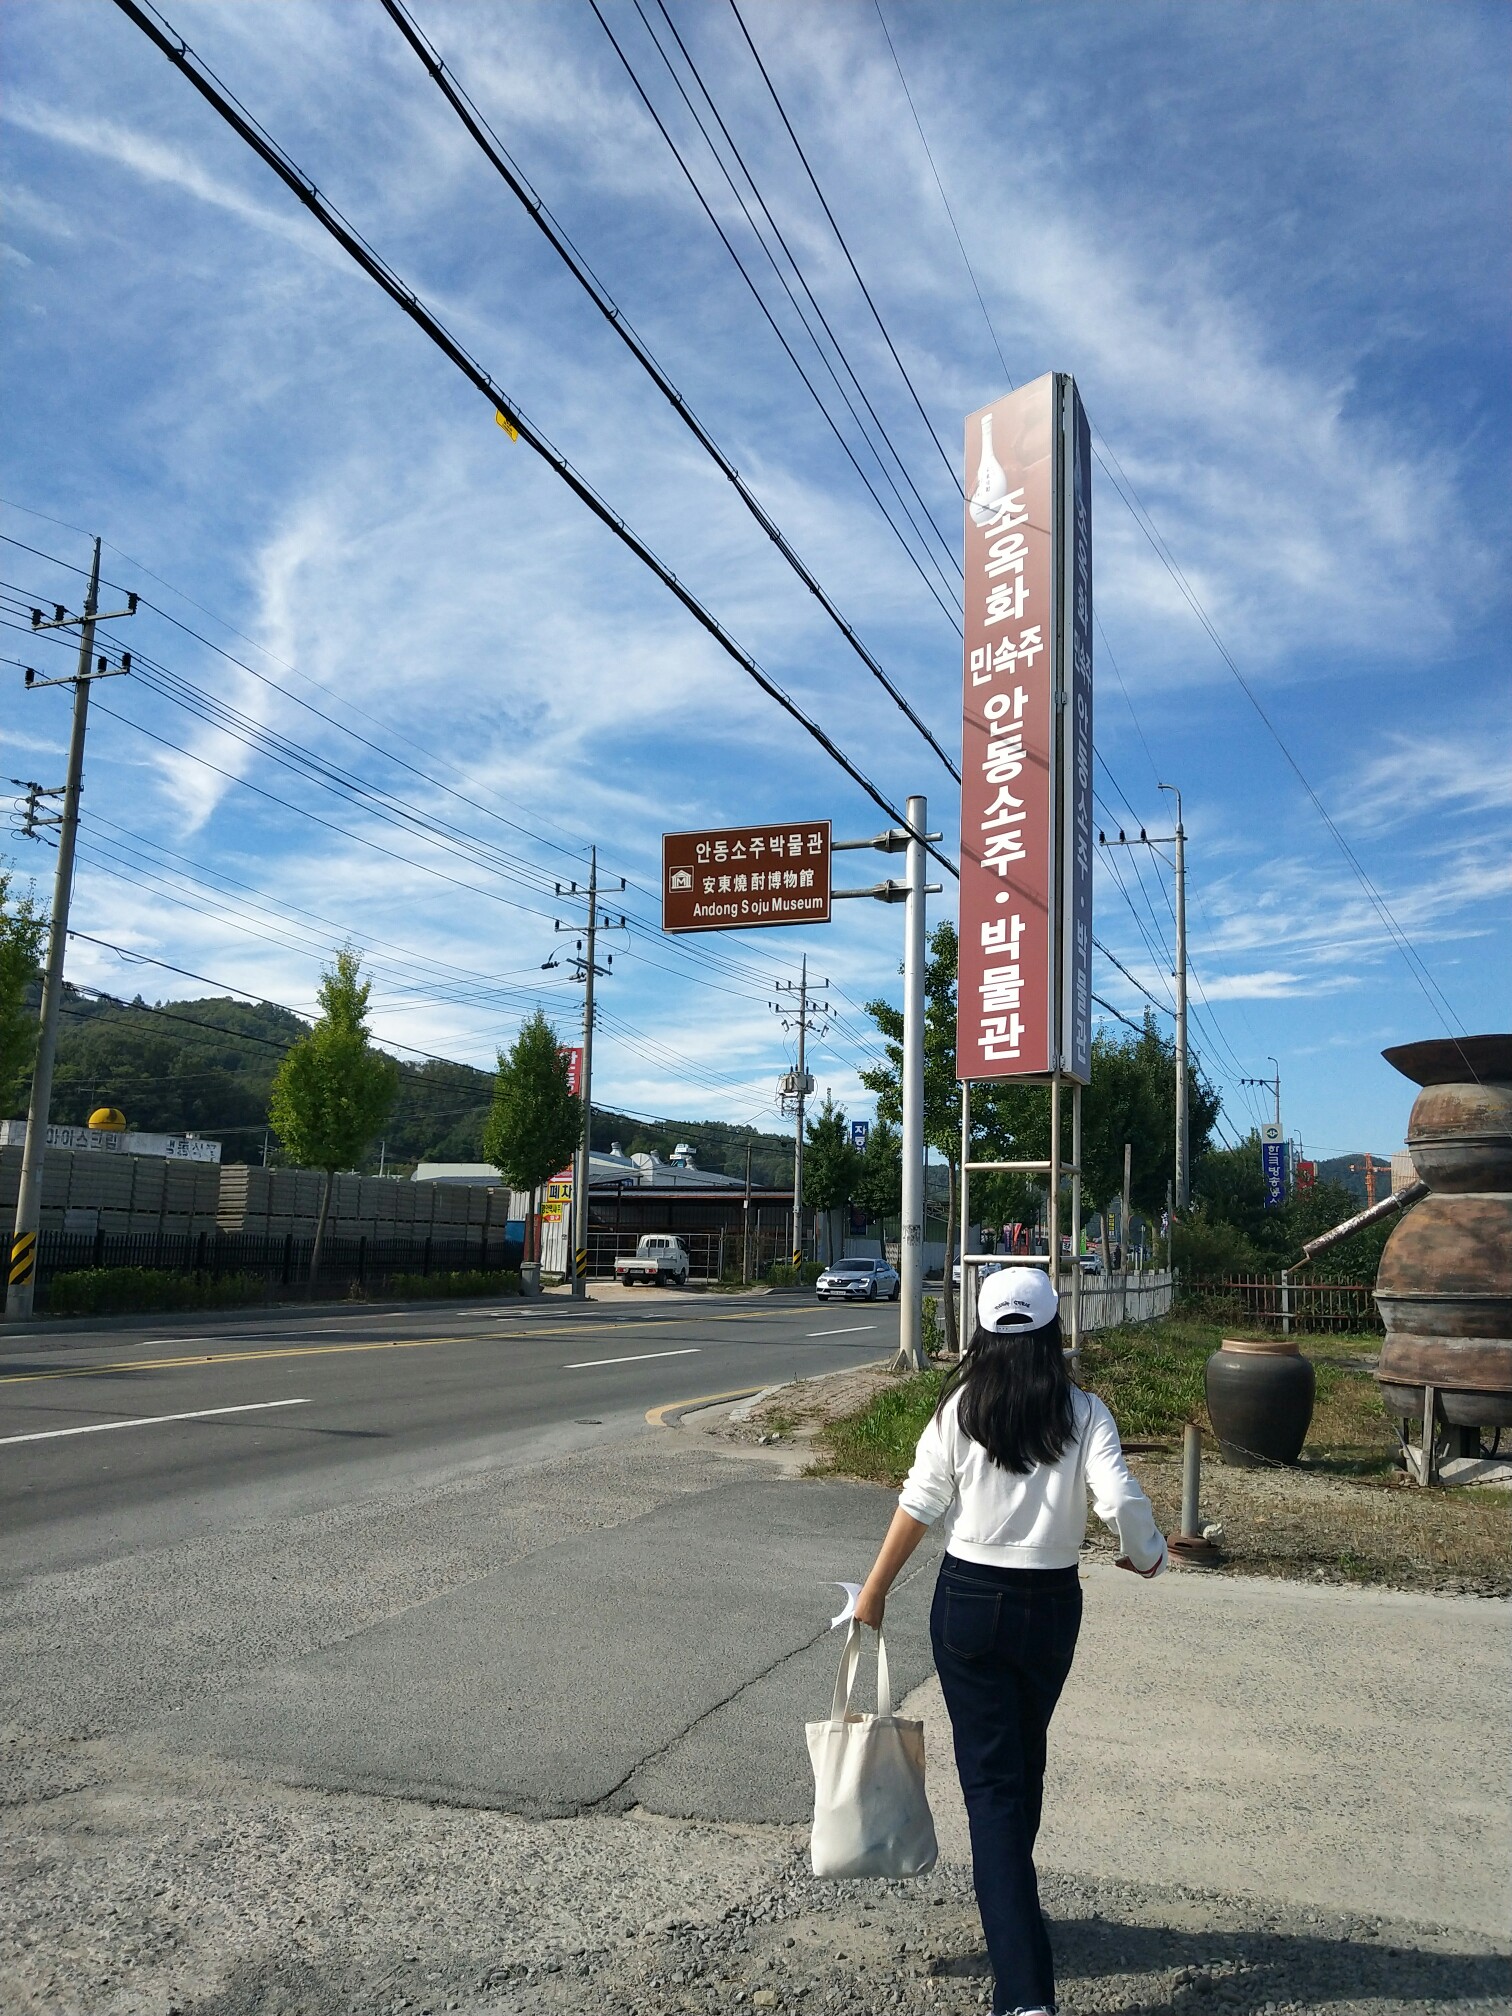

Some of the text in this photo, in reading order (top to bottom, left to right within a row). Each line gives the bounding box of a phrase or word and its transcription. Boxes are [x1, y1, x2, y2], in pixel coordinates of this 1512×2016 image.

[976, 487, 1030, 627] 조옥화
[970, 624, 1044, 687] 민속주
[695, 832, 823, 863] 안동소주박물관
[702, 868, 814, 894] 安東燒酎博物館
[977, 685, 1028, 1061] 안동소주 박물관
[693, 897, 823, 918] Andong Soju Museum
[46, 1127, 118, 1151] 아이스크림
